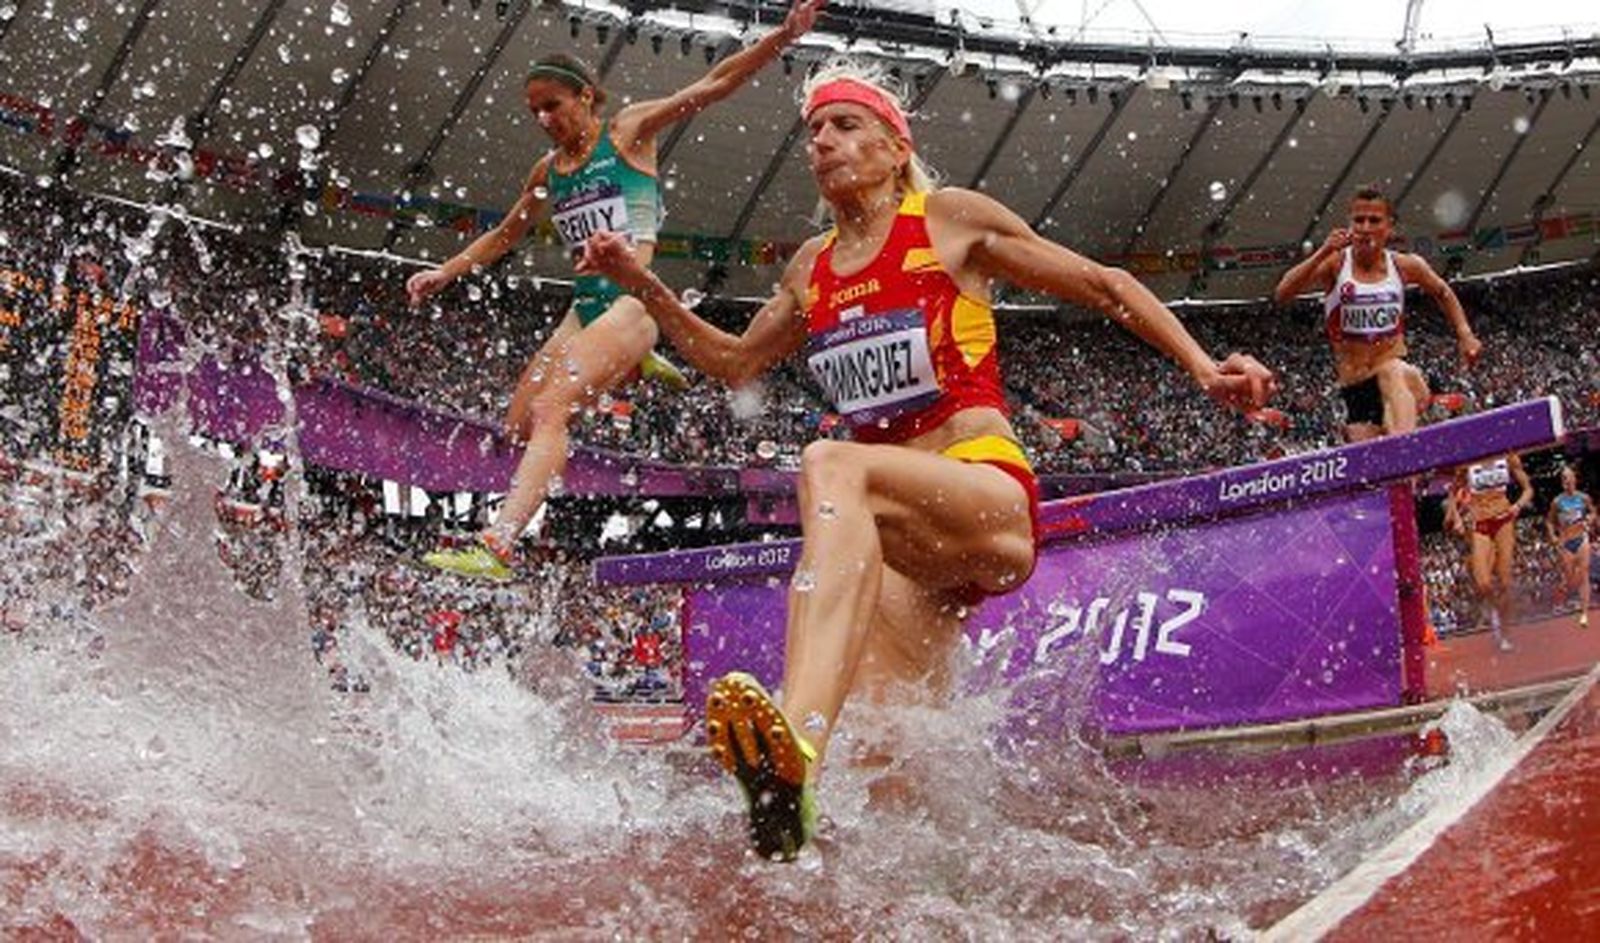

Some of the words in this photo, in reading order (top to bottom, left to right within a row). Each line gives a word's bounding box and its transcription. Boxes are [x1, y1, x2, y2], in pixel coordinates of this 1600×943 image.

[1219, 470, 1296, 503] London
[1300, 456, 1349, 486] 2012
[757, 547, 791, 567] 2012
[1034, 588, 1206, 666] 2012
